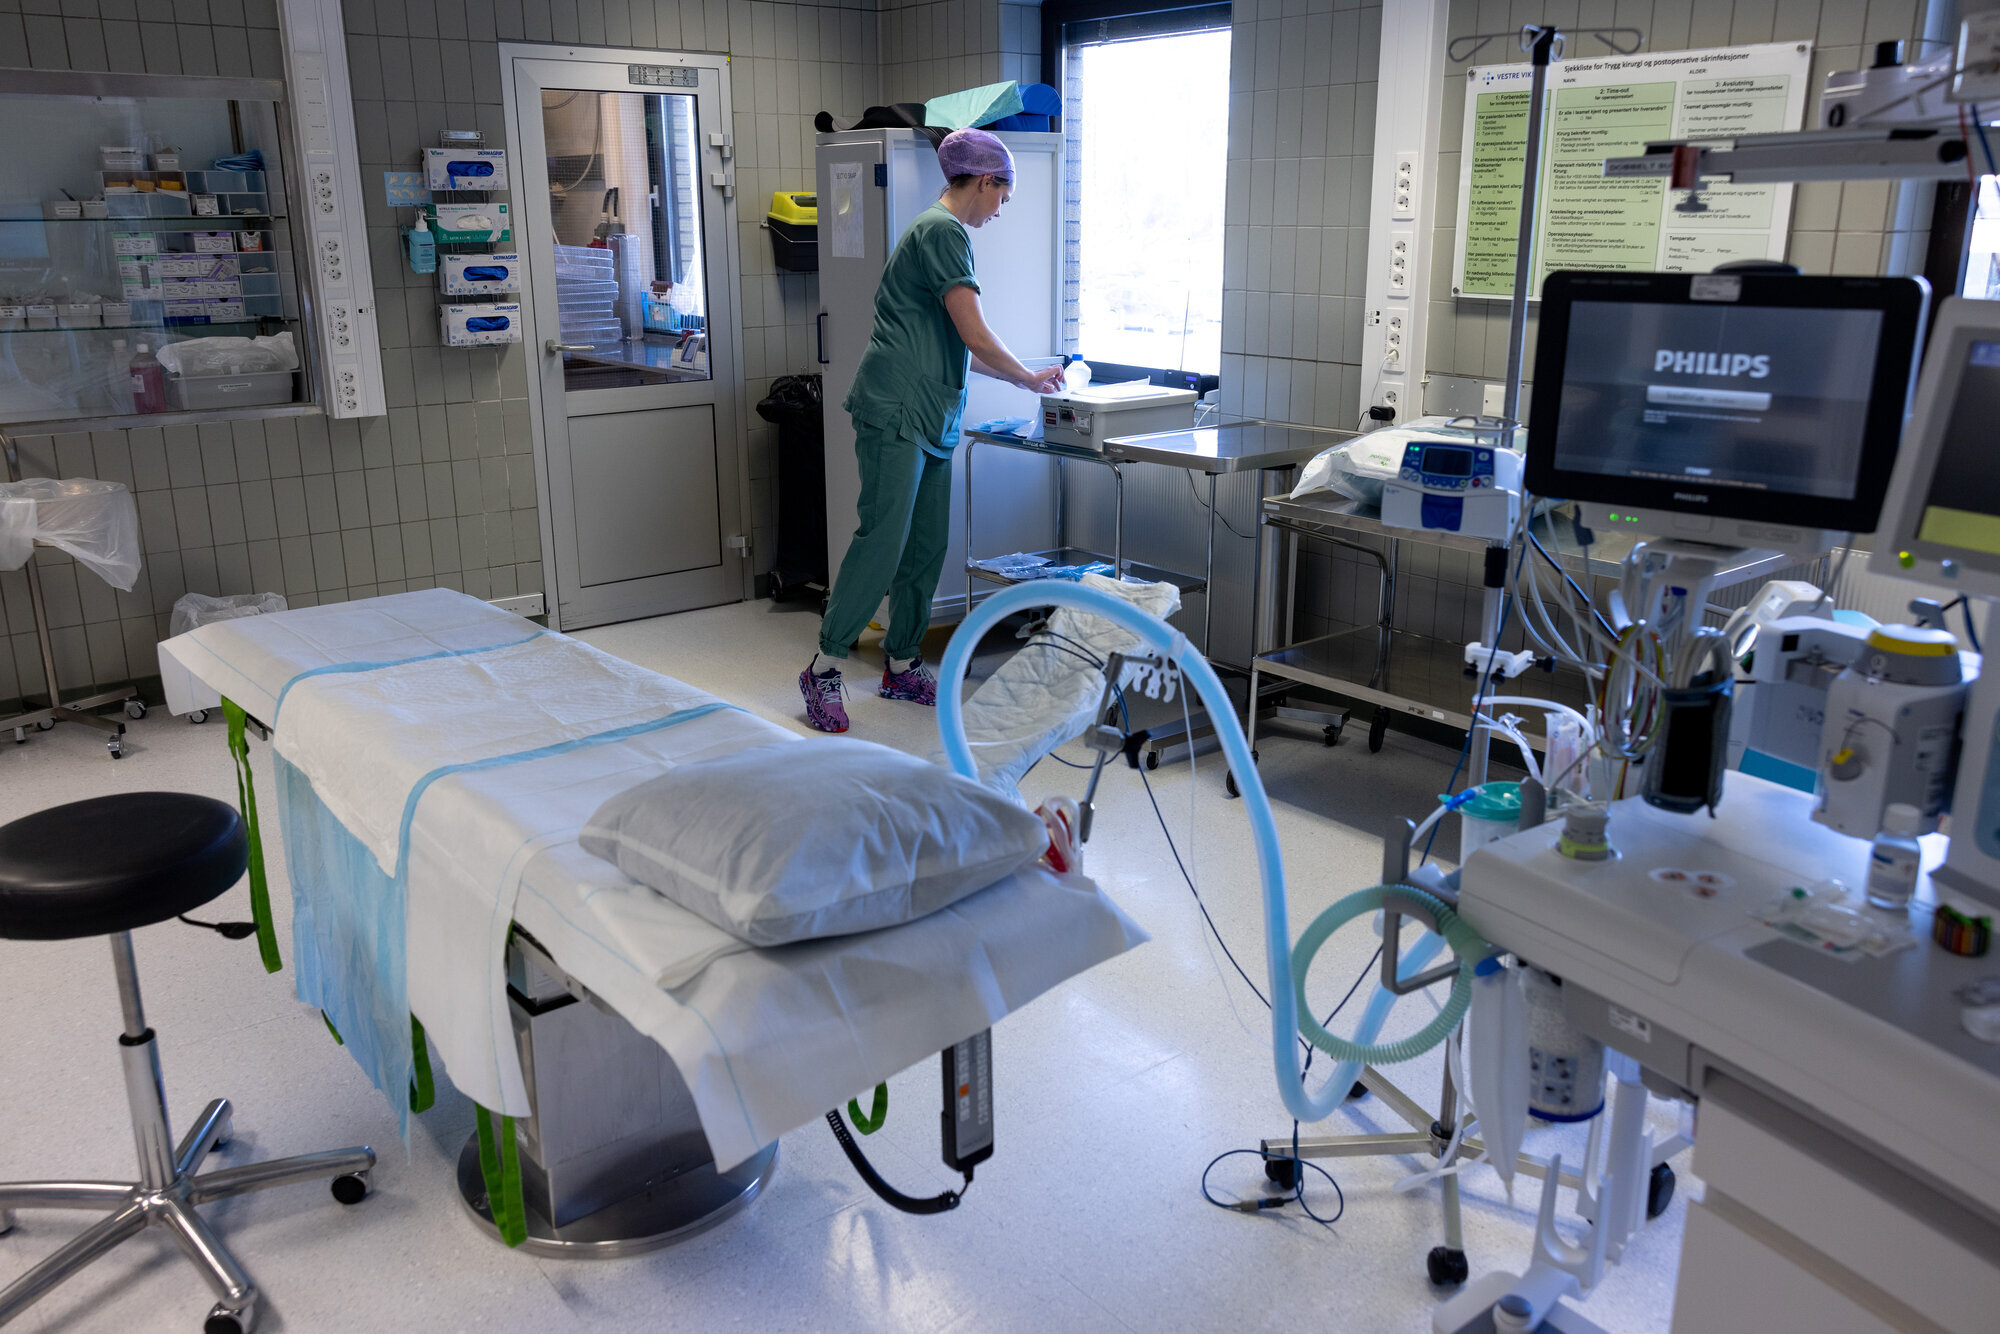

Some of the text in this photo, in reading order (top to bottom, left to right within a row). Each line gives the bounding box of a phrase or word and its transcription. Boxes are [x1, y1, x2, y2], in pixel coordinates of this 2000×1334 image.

[1564, 64, 1592, 73] Sjekkliste
[1605, 62, 1621, 70] Trygg
[1622, 60, 1642, 68] kirurgi
[1654, 57, 1699, 67] postoperative
[1700, 53, 1749, 62] sårinfeksjoner
[1654, 349, 1770, 379] PHILIPS
[1673, 492, 1709, 503] PHILIPS
